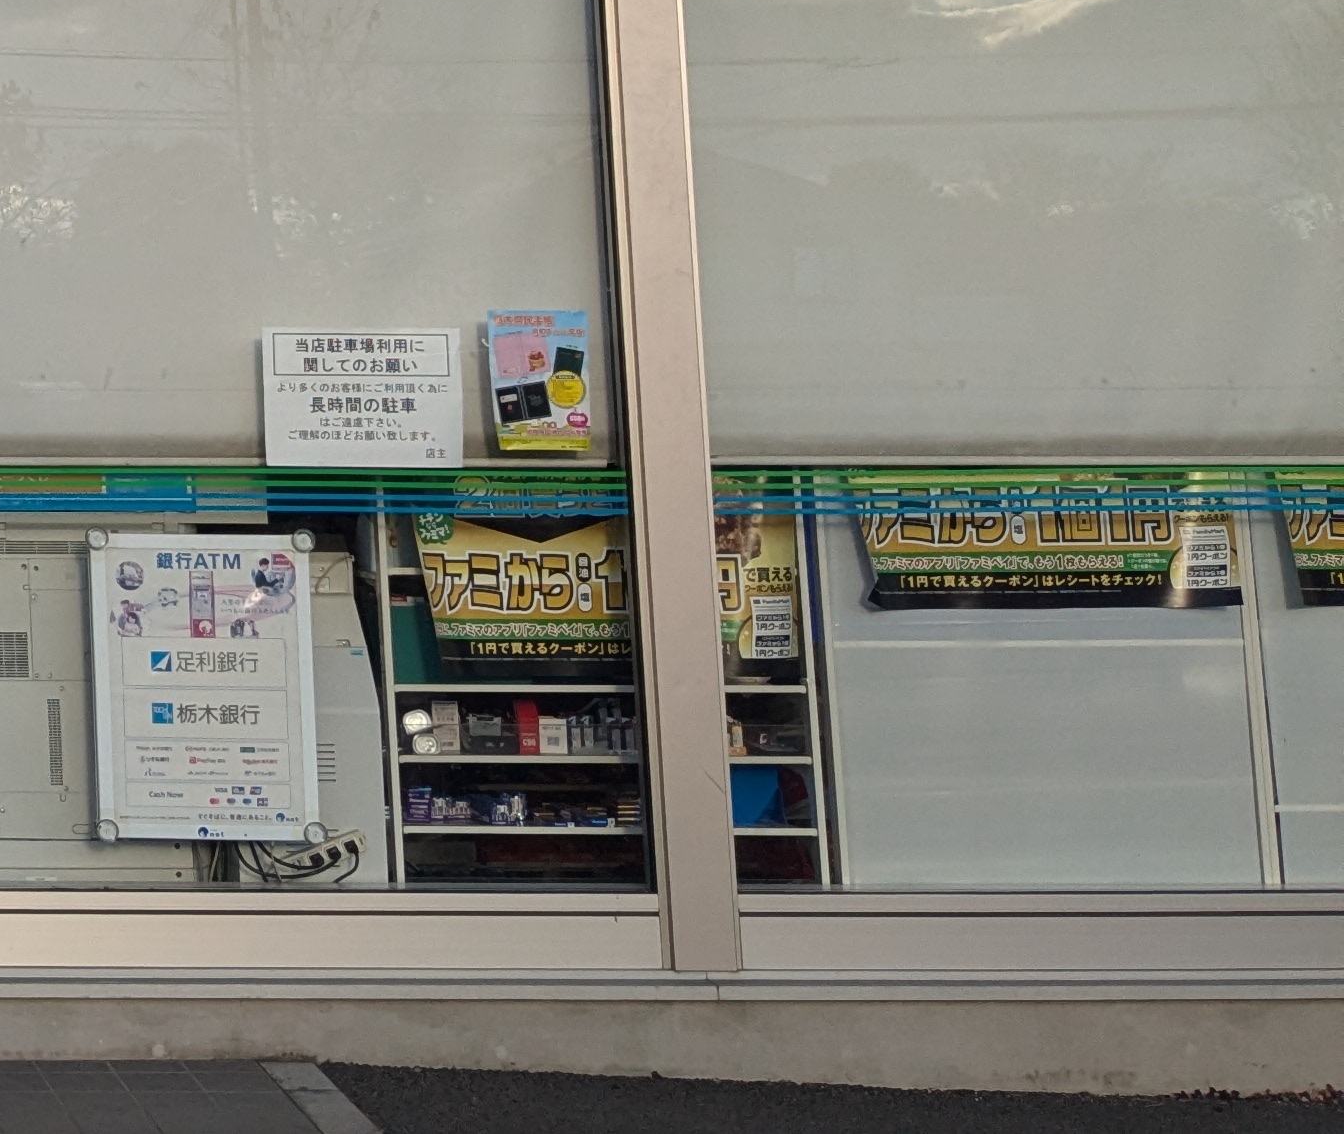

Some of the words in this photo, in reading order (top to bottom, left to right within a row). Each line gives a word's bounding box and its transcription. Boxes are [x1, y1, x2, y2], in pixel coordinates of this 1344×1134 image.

[294, 338, 425, 354] 当店駐車場利用に
[303, 357, 418, 373] 関してのお願い
[309, 397, 418, 414] 長時間の駐車
[319, 417, 403, 429] はご遠慮下さい。
[287, 430, 437, 442] ご理解のほどお願い致します。
[425, 448, 448, 459] 店主
[156, 552, 241, 570] 銀行ATM
[422, 549, 576, 614] ファミから
[175, 651, 259, 673] 足利銀行
[176, 703, 260, 725] 栃木銀行
